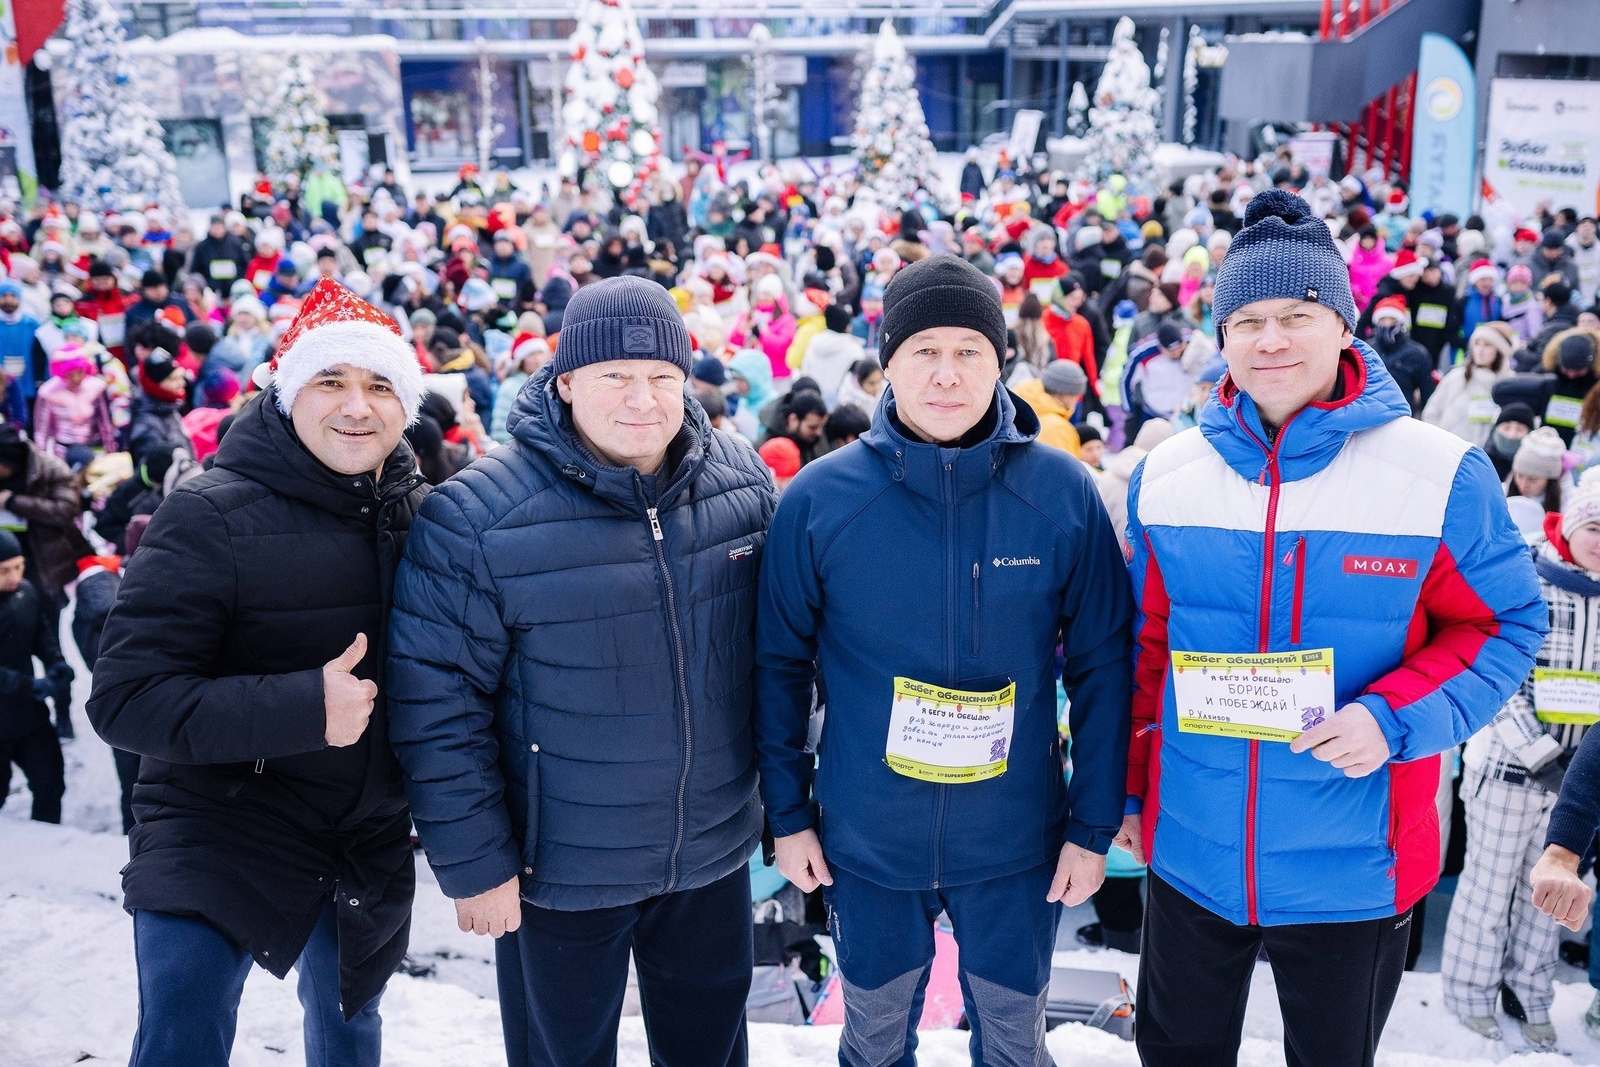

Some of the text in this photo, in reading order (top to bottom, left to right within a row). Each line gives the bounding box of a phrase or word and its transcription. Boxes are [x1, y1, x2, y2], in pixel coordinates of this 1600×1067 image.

[1002, 556, 1040, 566] Columbia
[1354, 560, 1407, 574] MOAX
[1183, 654, 1222, 663] Забег
[1226, 654, 1296, 665] обещаний
[904, 681, 934, 696] Забег
[937, 690, 997, 704] обещаний
[1228, 684, 1278, 697] БОРИСЬ
[1206, 697, 1213, 705] И
[929, 708, 946, 717] БЕГУ
